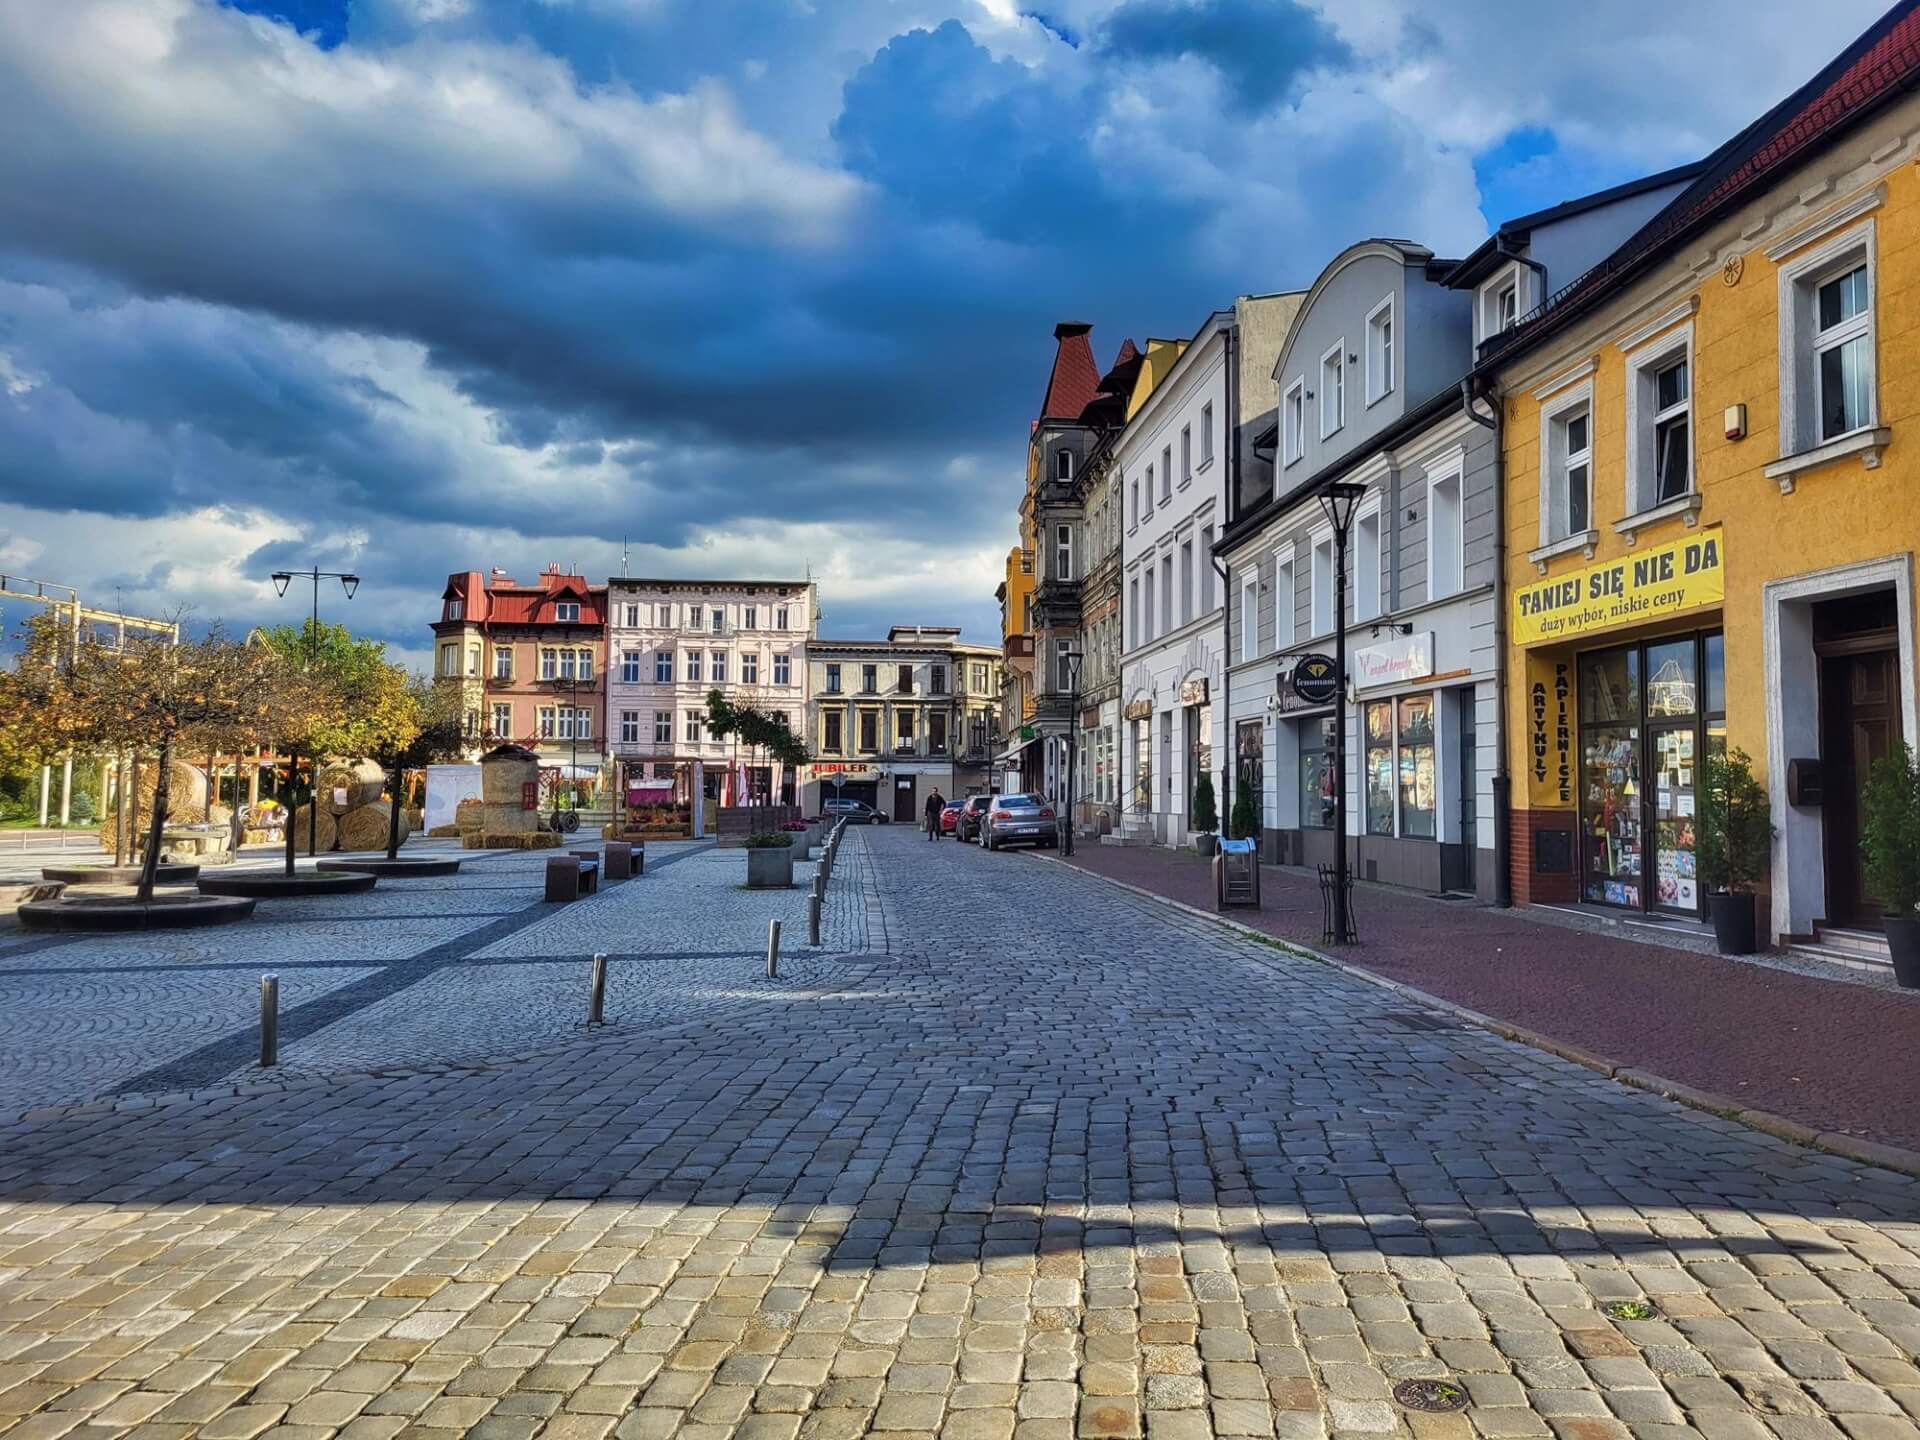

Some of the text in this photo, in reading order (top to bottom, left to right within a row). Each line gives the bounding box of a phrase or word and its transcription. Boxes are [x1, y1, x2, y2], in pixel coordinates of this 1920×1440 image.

[1519, 539, 1719, 617] TANIEJ SIĘ NIE DA
[1540, 588, 1686, 634] duży wybór, niskie ceny
[813, 763, 868, 773] JUBILER
[1532, 682, 1547, 783] ARTYKUŁY
[1555, 663, 1570, 801] PAPIERNICZE
